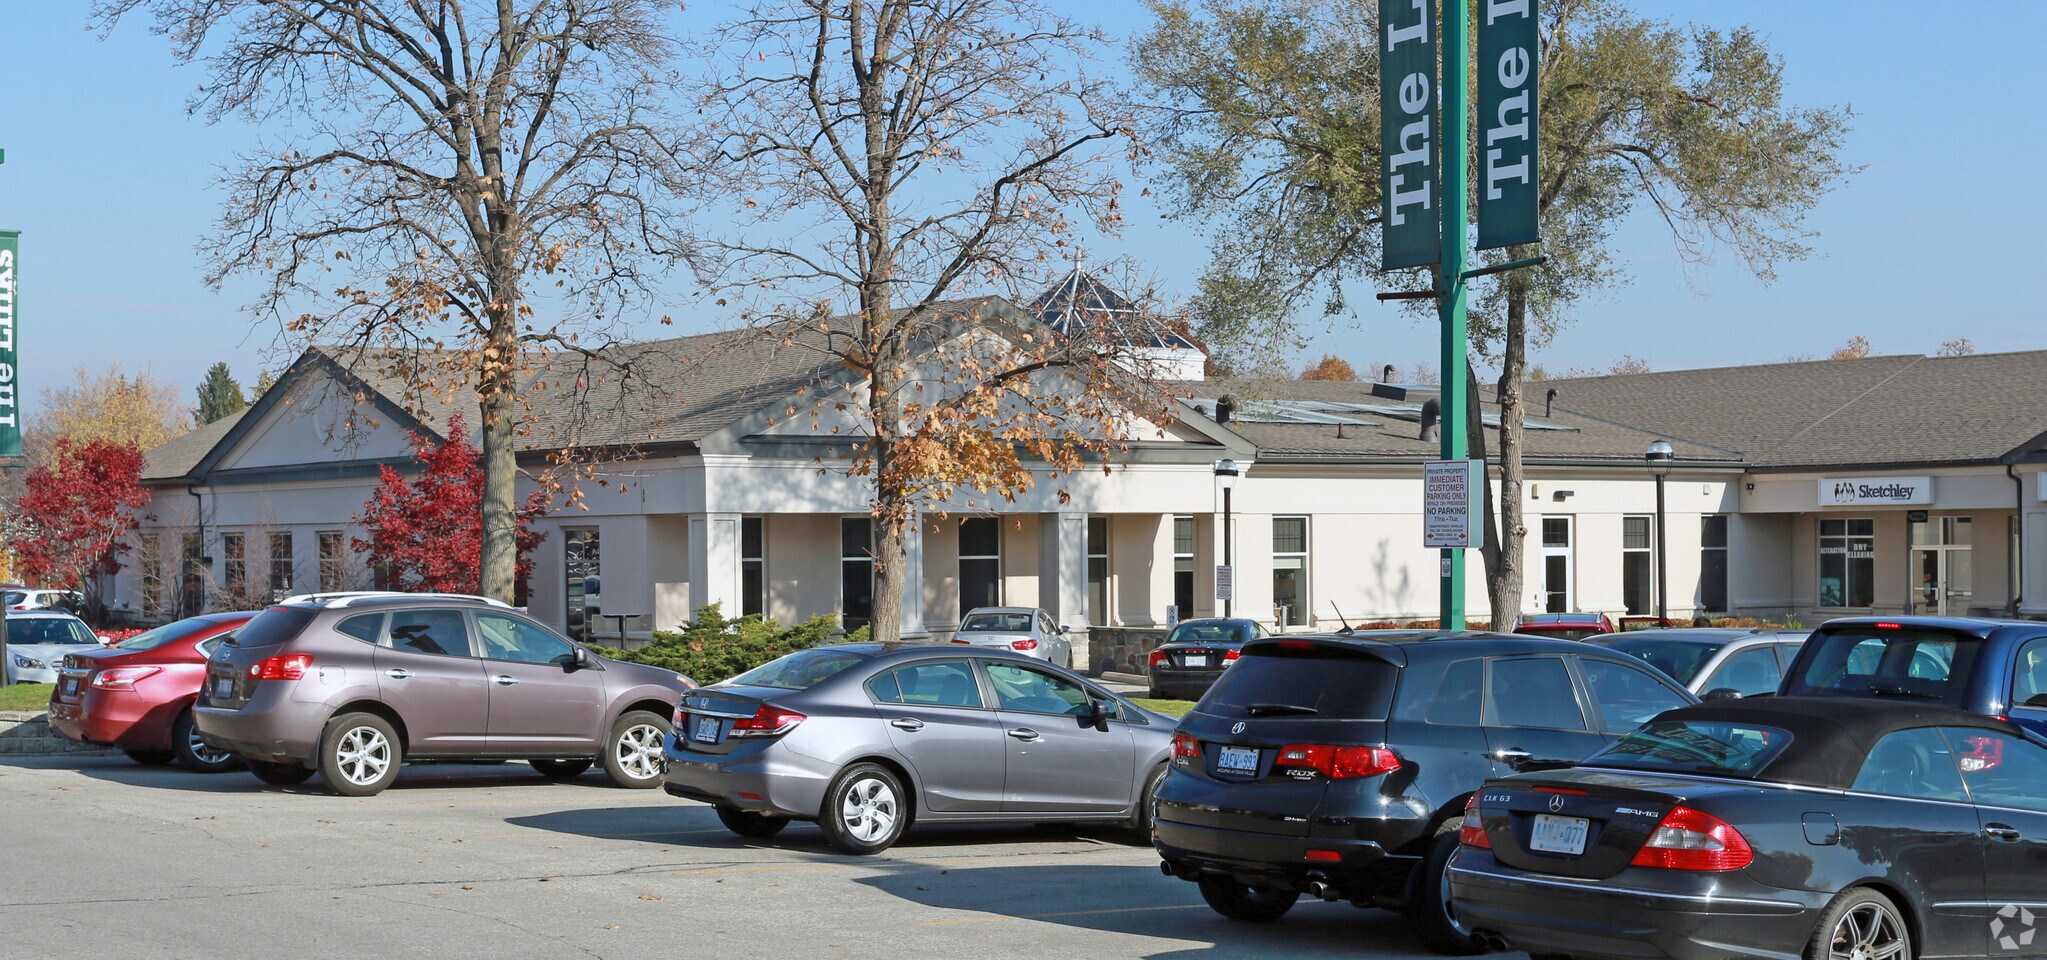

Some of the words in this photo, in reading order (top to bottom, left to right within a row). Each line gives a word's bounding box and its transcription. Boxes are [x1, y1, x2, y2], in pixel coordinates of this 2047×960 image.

[1487, 46, 1529, 200] The
[1390, 72, 1430, 226] The
[1430, 475, 1463, 483] IMMEDIATE
[1859, 483, 1914, 500] Sketchley
[1427, 507, 1436, 515] NO
[1438, 507, 1466, 515] PARKING
[1853, 543, 1867, 551] DRY
[1286, 769, 1317, 777] RDX
[1484, 794, 1498, 802] CLK
[1628, 808, 1659, 817] AMG
